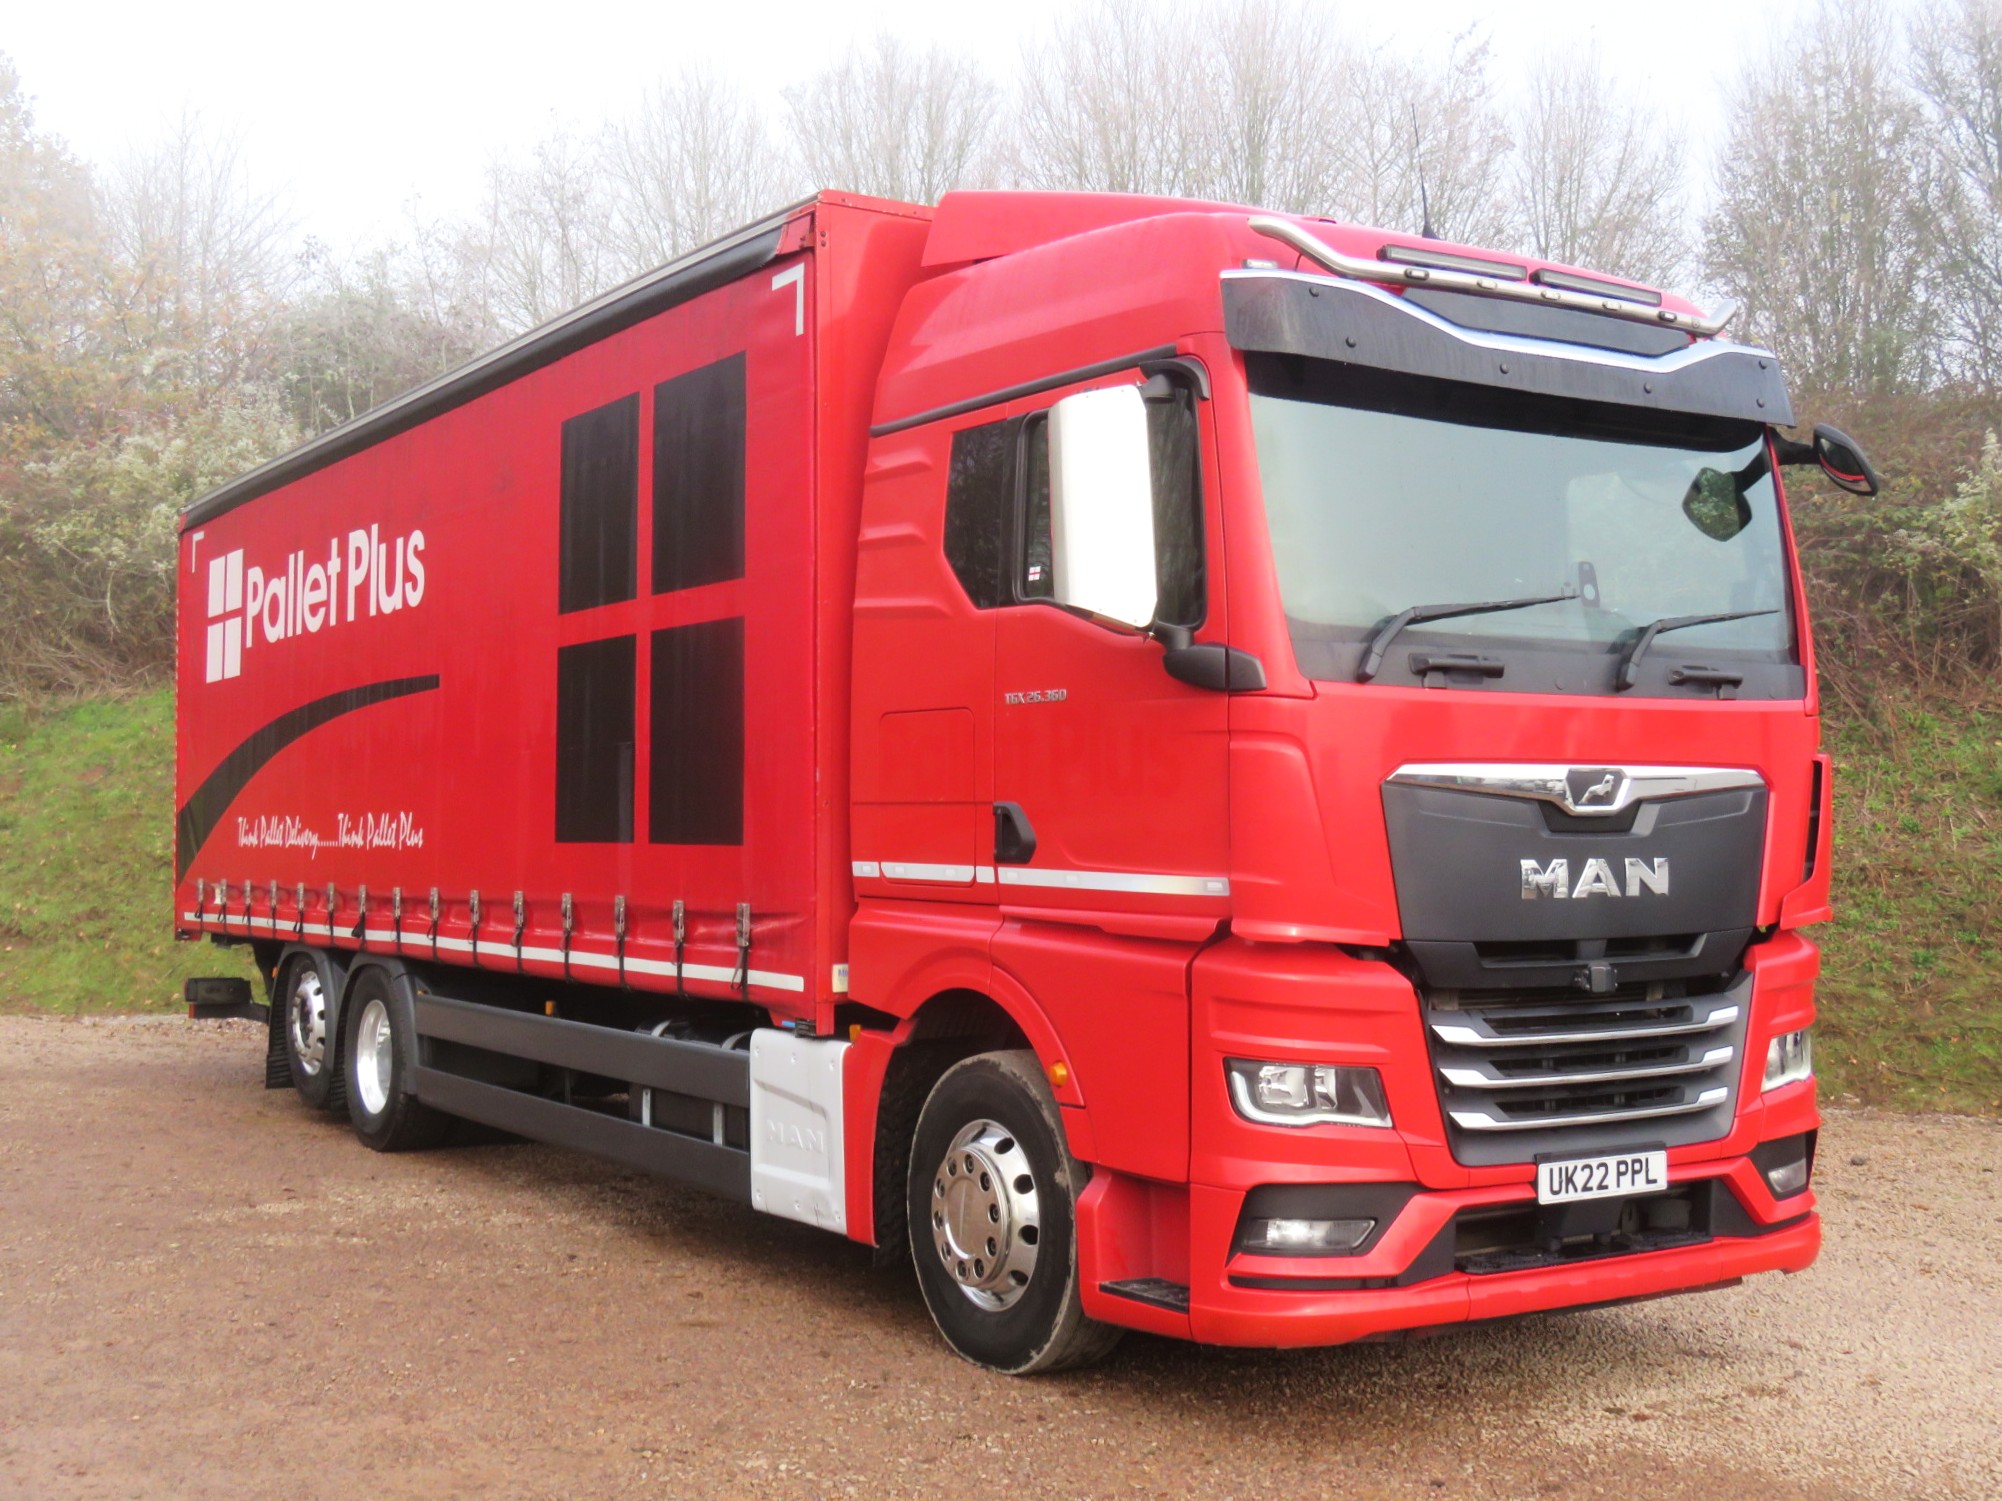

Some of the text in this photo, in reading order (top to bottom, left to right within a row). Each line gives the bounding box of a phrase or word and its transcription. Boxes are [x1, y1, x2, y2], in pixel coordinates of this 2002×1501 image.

[246, 523, 425, 648] Pallet Plus
[1004, 688, 1067, 704] TGX 26.360
[238, 816, 259, 848] Think
[260, 815, 284, 848] Pallet
[366, 812, 397, 850] Pallet
[399, 811, 423, 850] Plus
[1520, 857, 1669, 899] MAN
[766, 1119, 824, 1153] MAN
[1549, 1157, 1658, 1196] UK22 PPL
